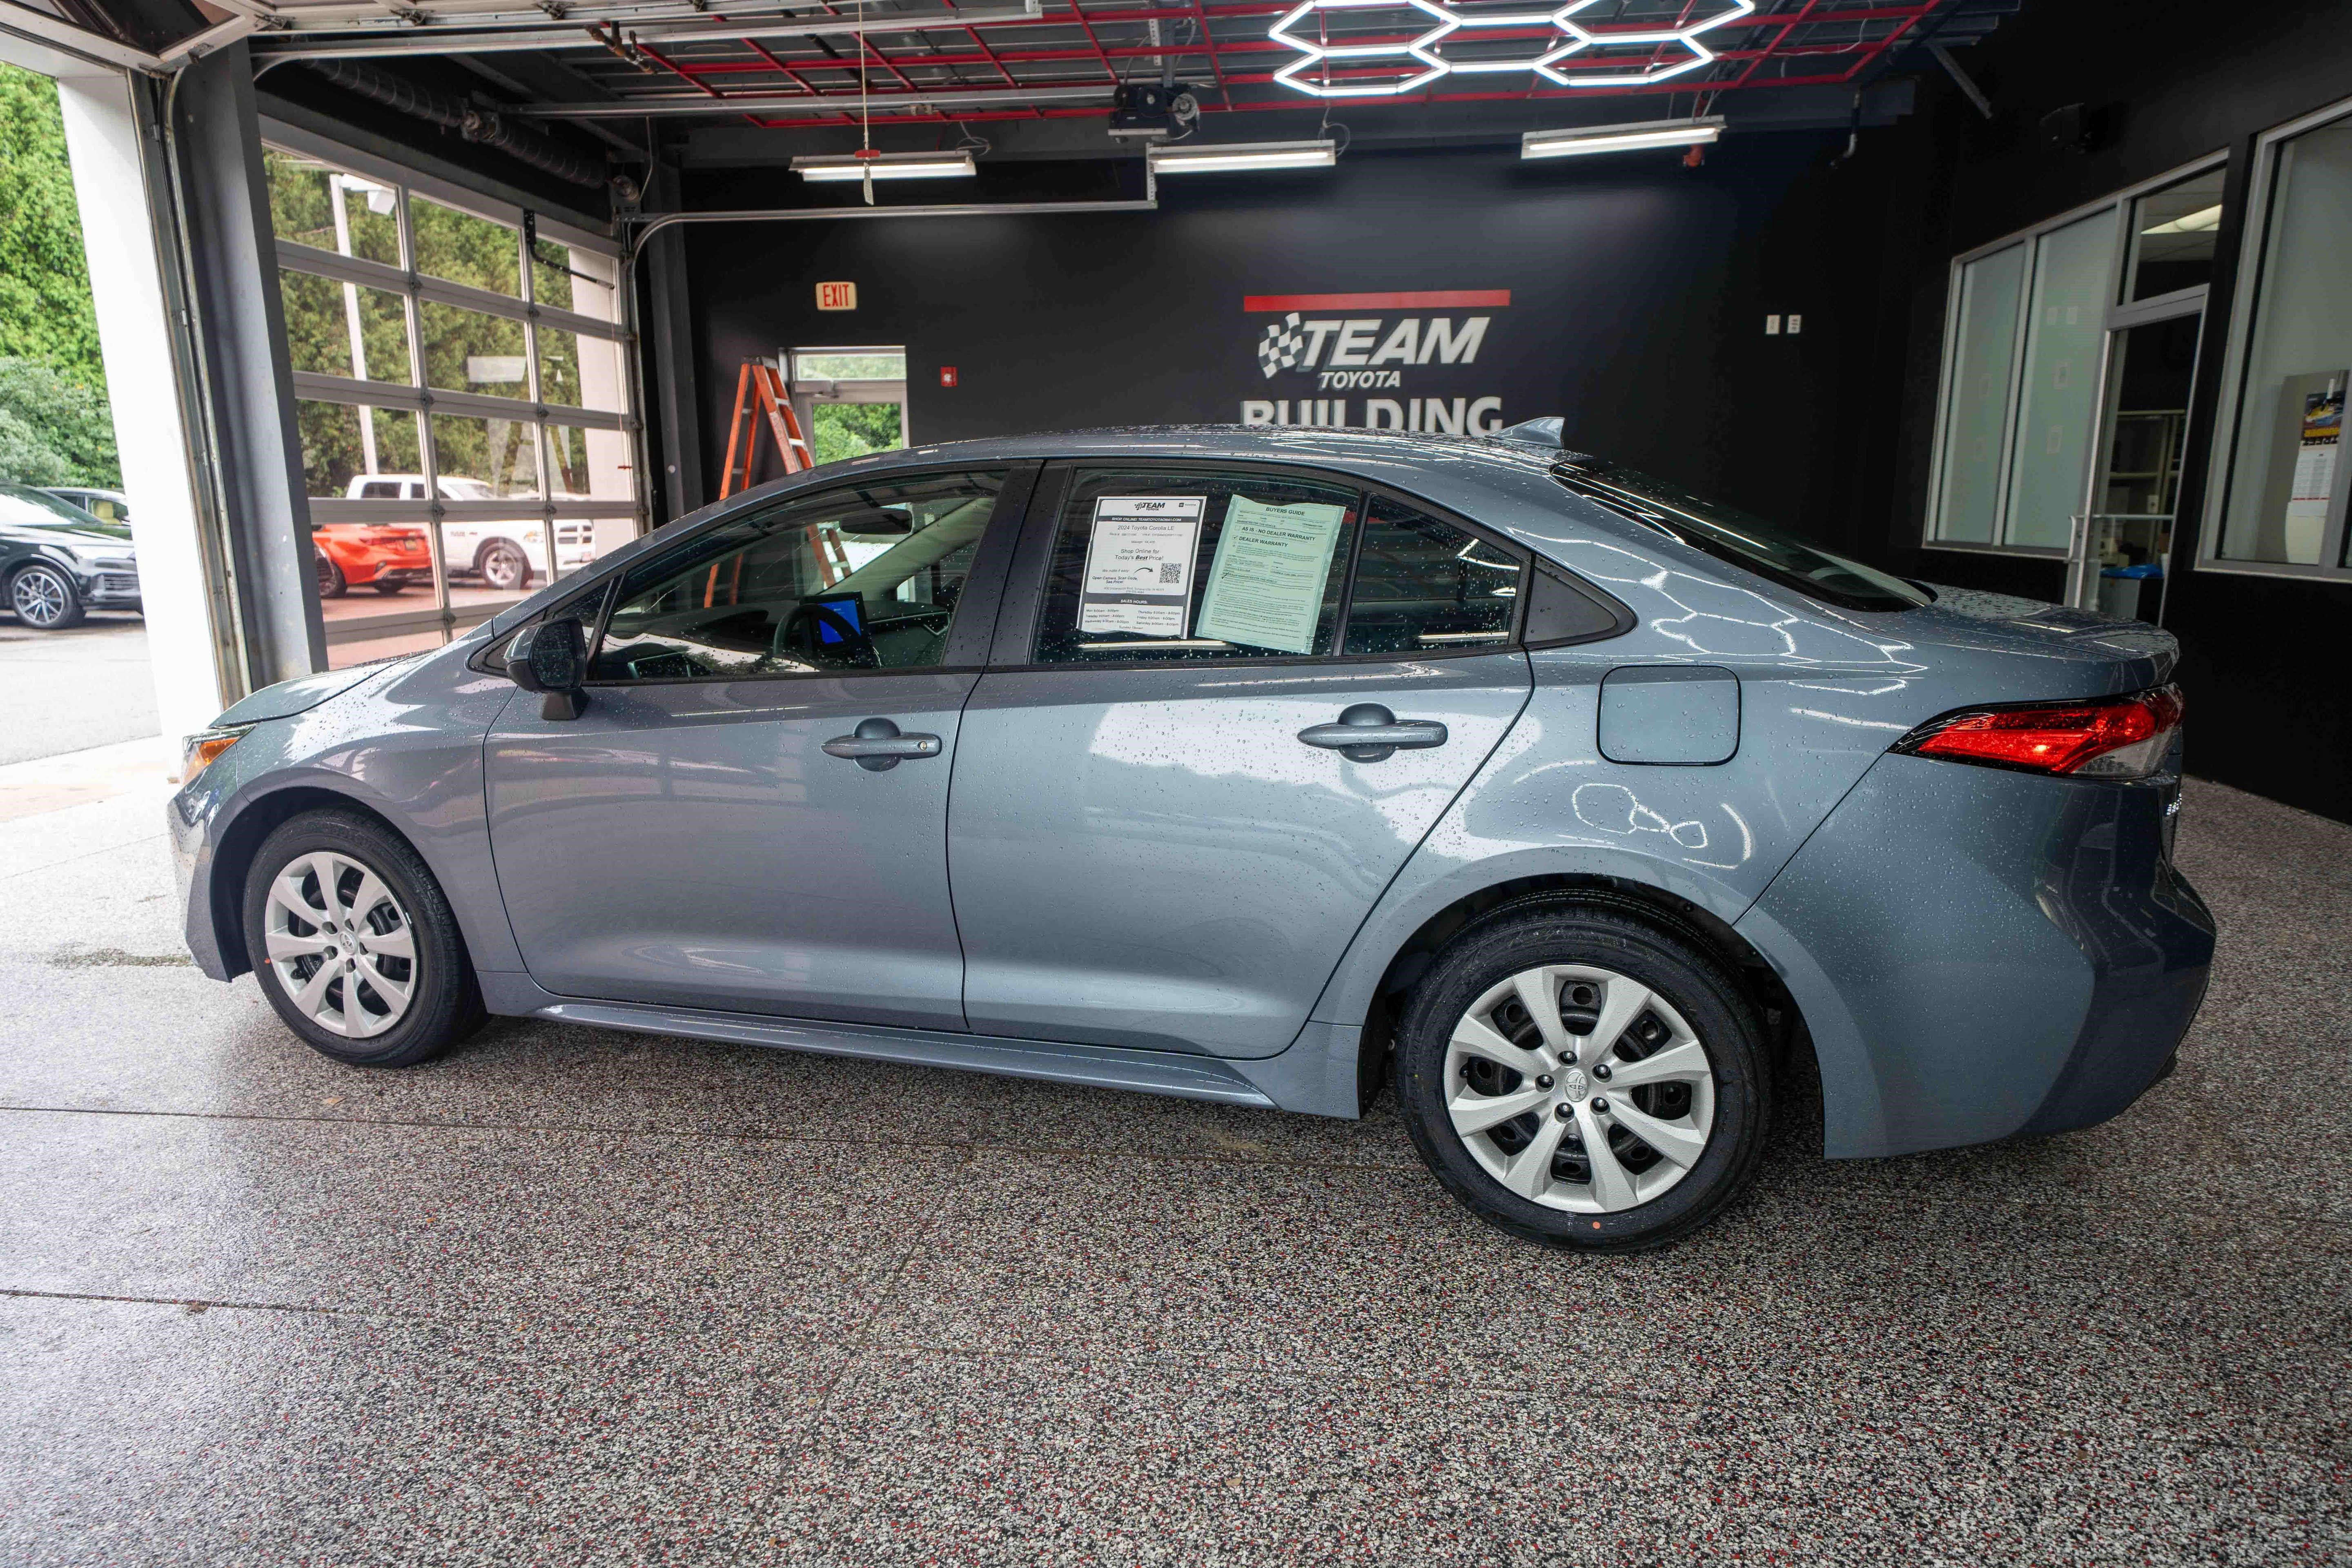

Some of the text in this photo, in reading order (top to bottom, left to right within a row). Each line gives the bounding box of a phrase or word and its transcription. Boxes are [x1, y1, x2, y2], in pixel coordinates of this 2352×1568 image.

[823, 284, 849, 307] EXIT
[1302, 317, 1491, 367] TEAM
[1319, 370, 1401, 389] TOYOTA
[1260, 539, 1288, 548] WARRANTY
[1287, 533, 1316, 541] WARRANTY
